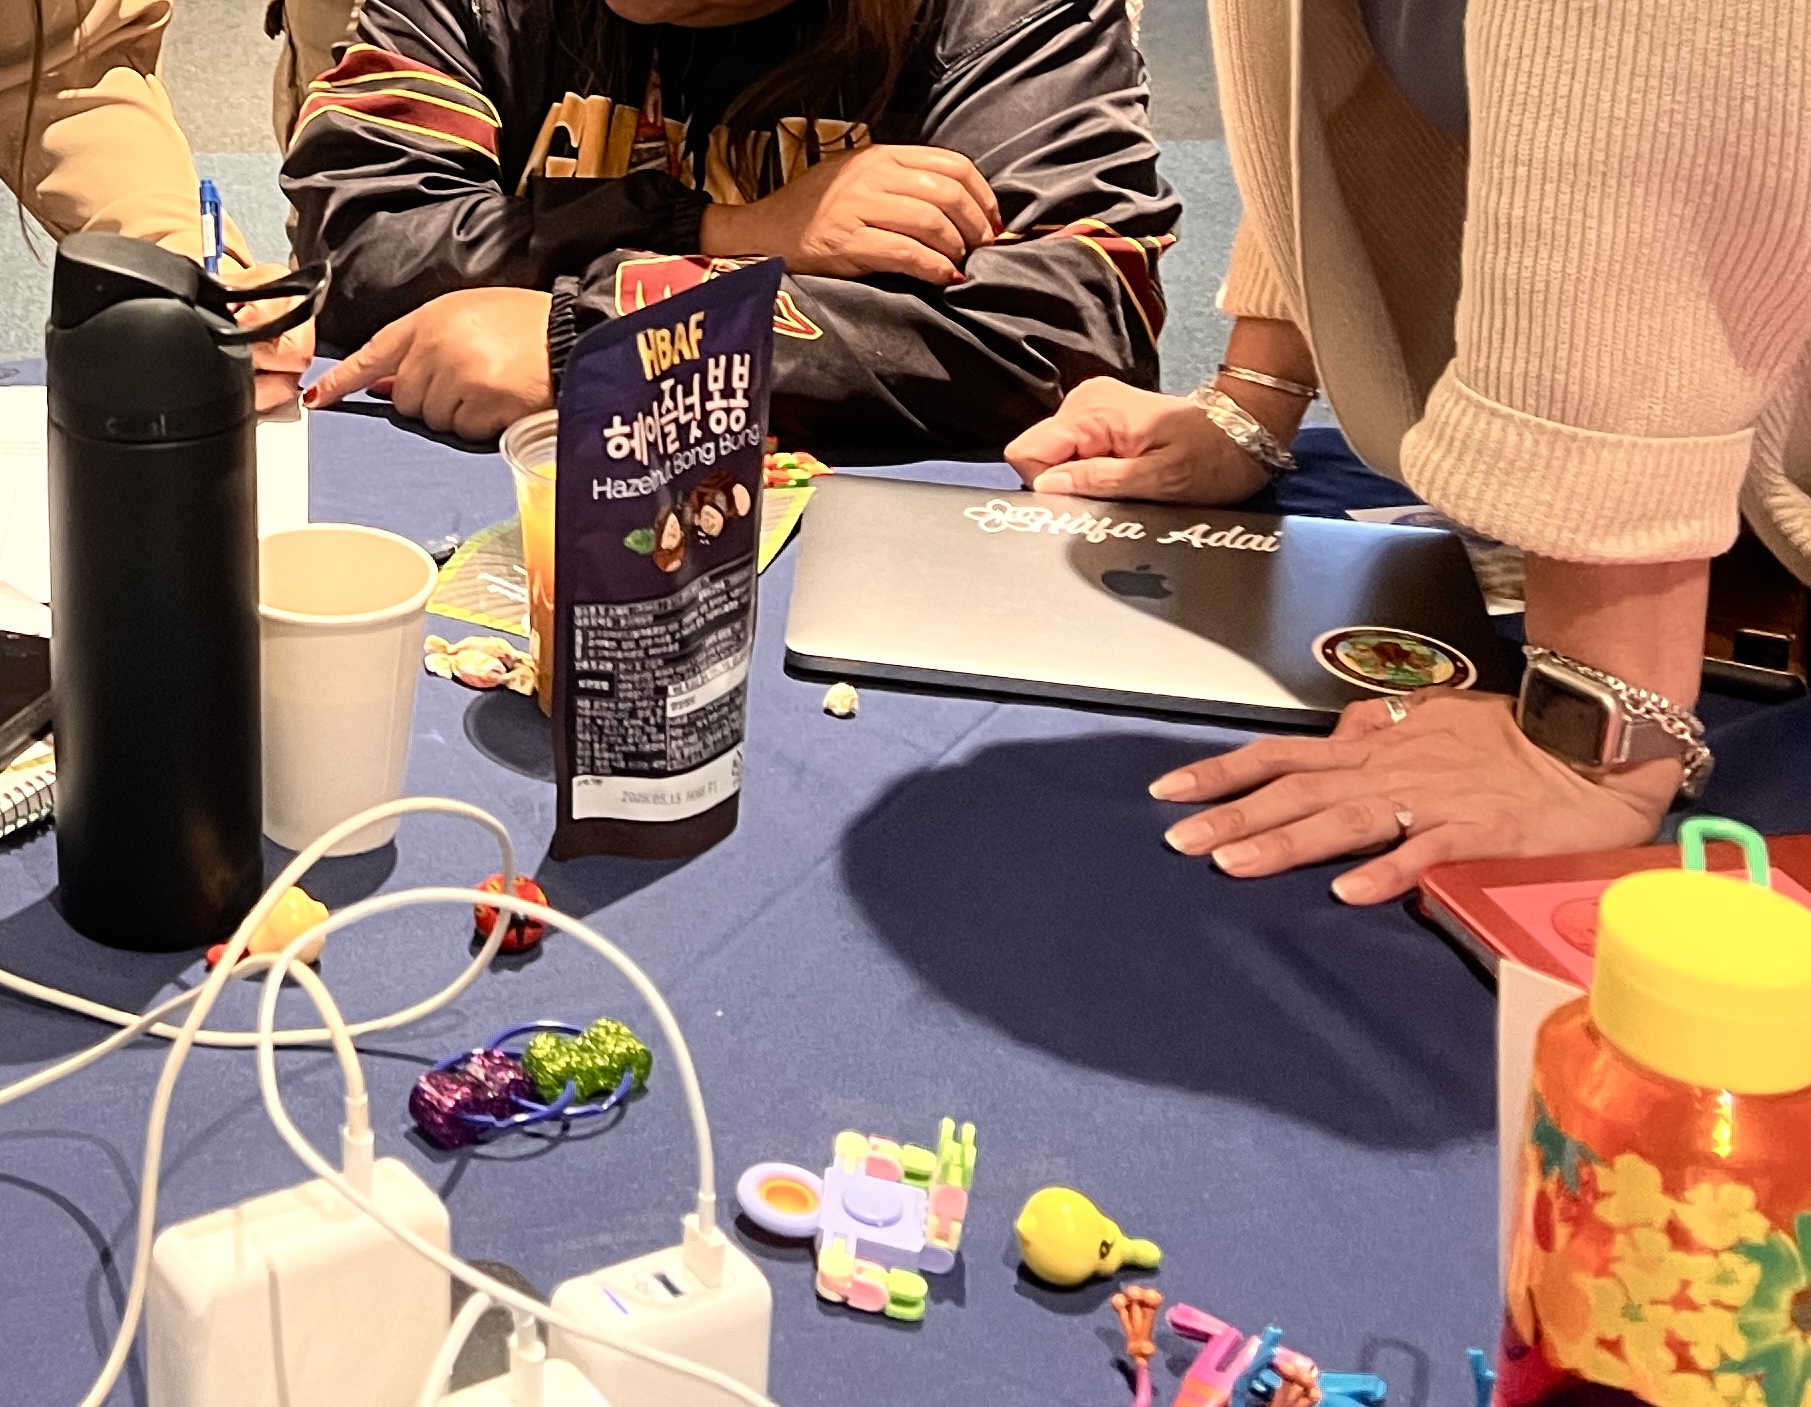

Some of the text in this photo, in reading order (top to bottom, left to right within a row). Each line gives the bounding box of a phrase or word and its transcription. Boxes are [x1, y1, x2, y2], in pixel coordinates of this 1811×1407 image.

[635, 311, 705, 380] HBAF
[672, 441, 716, 475] Bong
[719, 424, 761, 456] Bong
[1156, 523, 1283, 552] Adai
